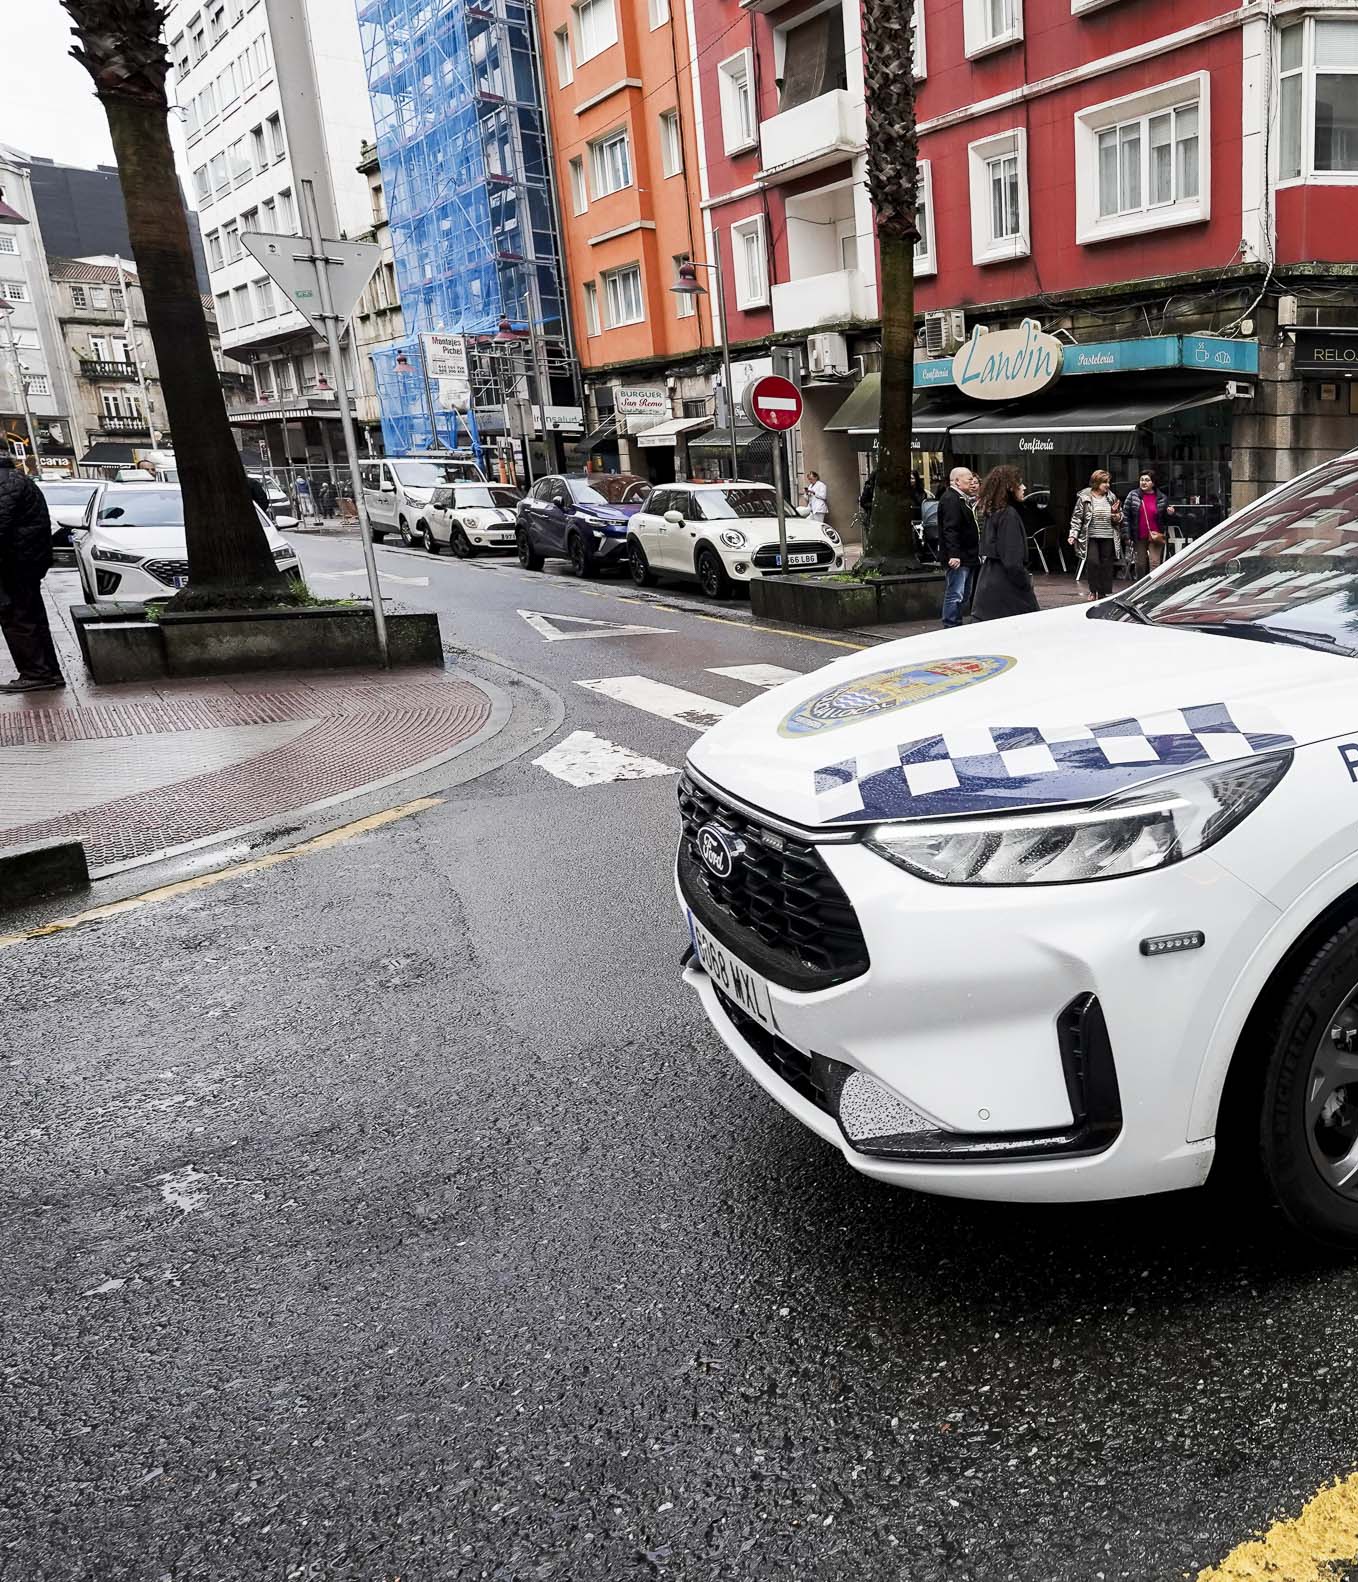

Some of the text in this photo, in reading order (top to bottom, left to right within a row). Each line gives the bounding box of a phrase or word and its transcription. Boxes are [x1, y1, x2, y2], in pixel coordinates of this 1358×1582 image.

[1077, 351, 1115, 366] Pastelería
[620, 390, 662, 399] BURGUER
[621, 398, 663, 408] San Remo
[1018, 437, 1054, 454] Confitería
[703, 833, 725, 871] Ford
